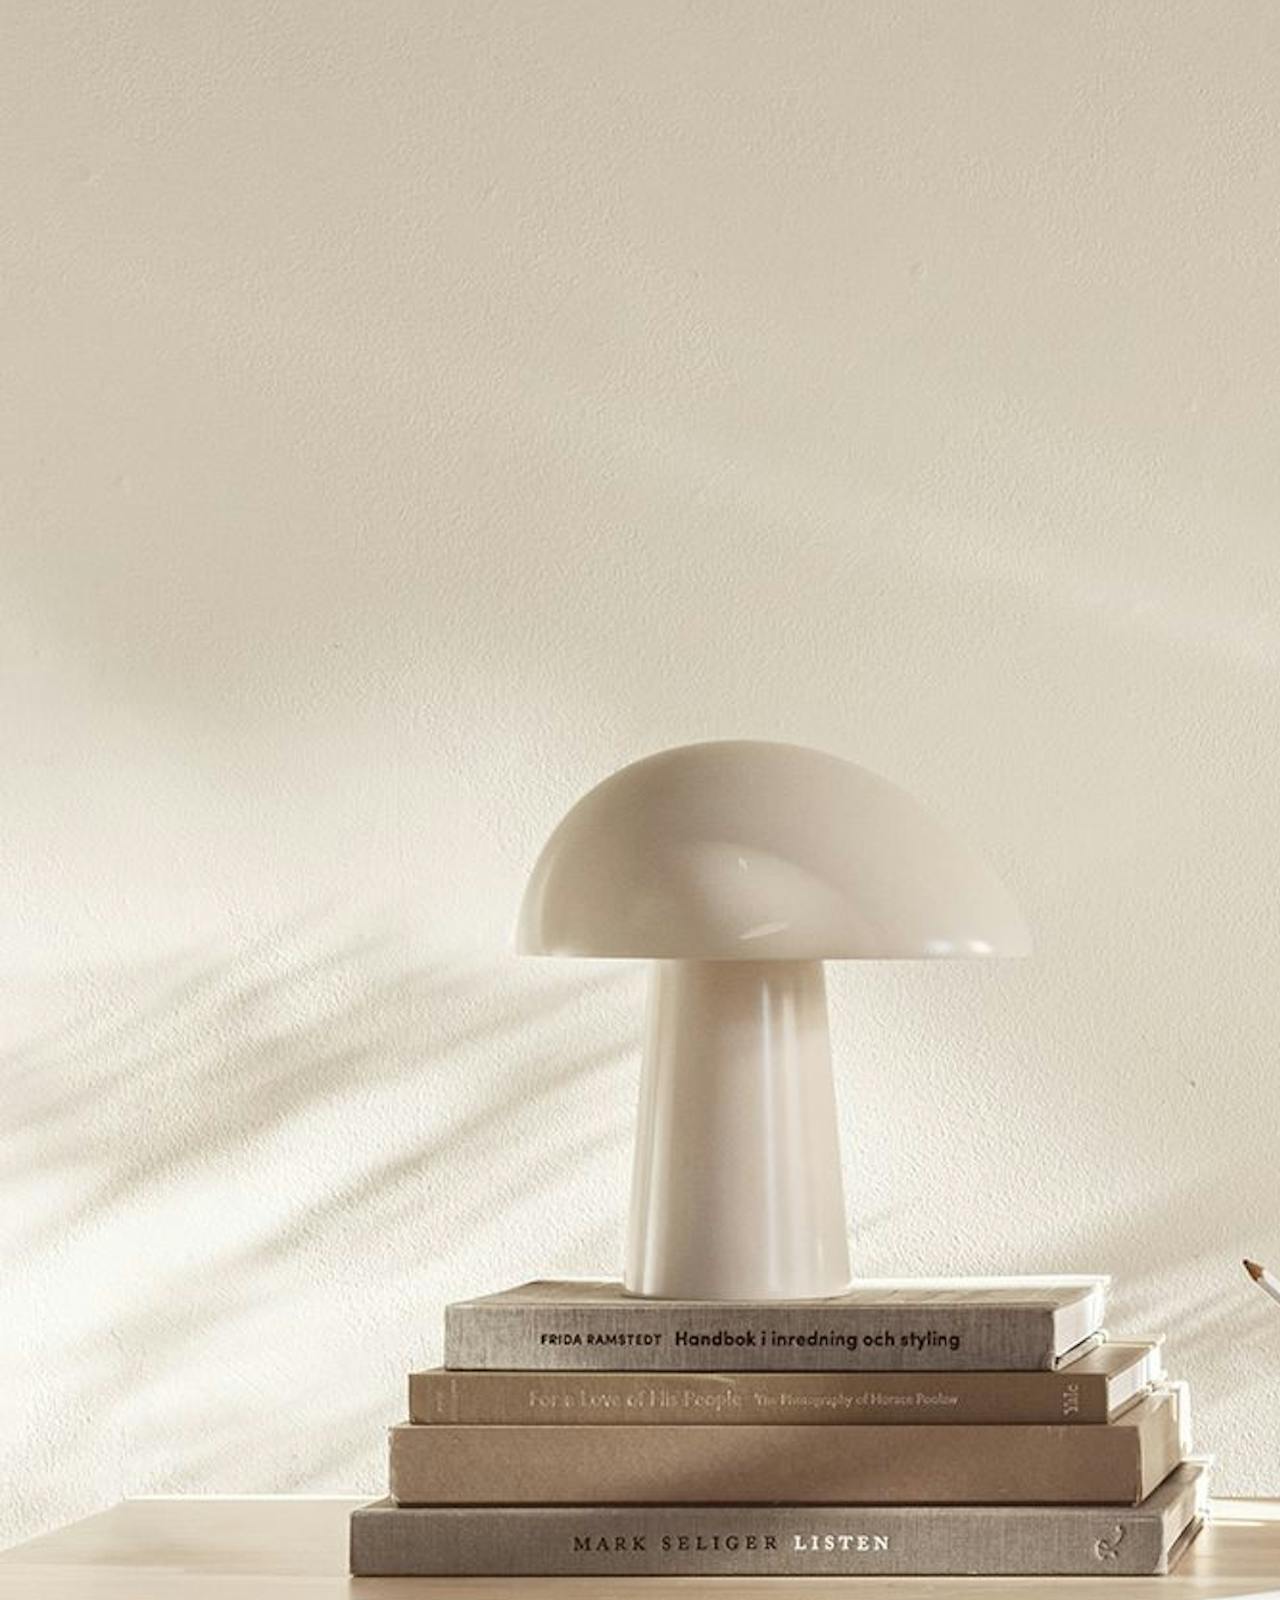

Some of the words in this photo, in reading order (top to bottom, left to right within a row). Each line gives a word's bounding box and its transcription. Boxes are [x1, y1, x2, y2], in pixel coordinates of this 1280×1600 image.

[540, 1333, 582, 1347] FRIDA
[586, 1333, 662, 1347] RAMSTEDT
[675, 1330, 756, 1347] Handbok
[760, 1330, 767, 1347] i
[771, 1330, 857, 1351] inredning
[863, 1330, 896, 1347] och
[901, 1330, 960, 1351] styling
[573, 1535, 647, 1552] MARK
[661, 1535, 779, 1552] SELIGER
[794, 1534, 890, 1552] LISTEN
